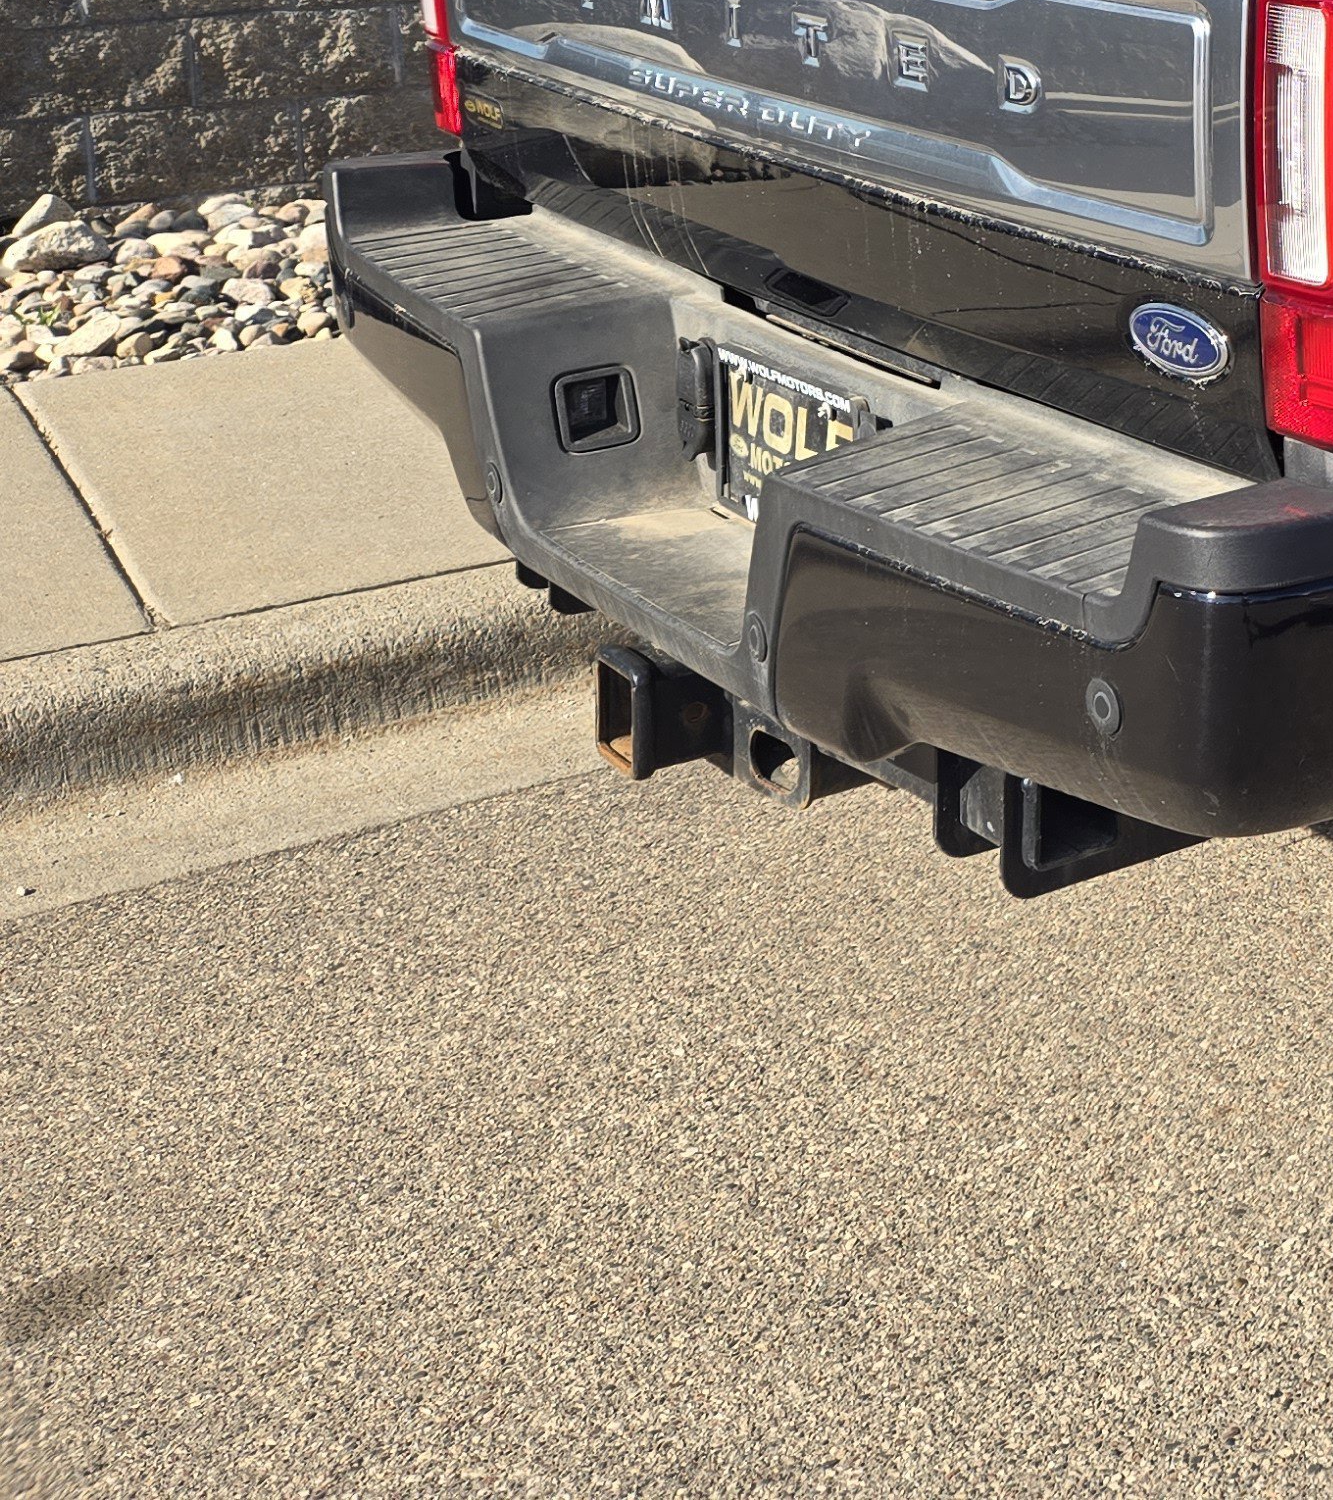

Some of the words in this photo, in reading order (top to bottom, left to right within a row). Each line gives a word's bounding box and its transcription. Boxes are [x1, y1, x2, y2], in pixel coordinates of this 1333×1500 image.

[628, 69, 750, 119] SUPER
[758, 103, 872, 147] DUTY
[1147, 316, 1199, 364] Ford
[717, 347, 851, 414] WWW.WOLFMOTORS.COM
[728, 372, 854, 461] WOLF
[750, 442, 791, 476] MOT
